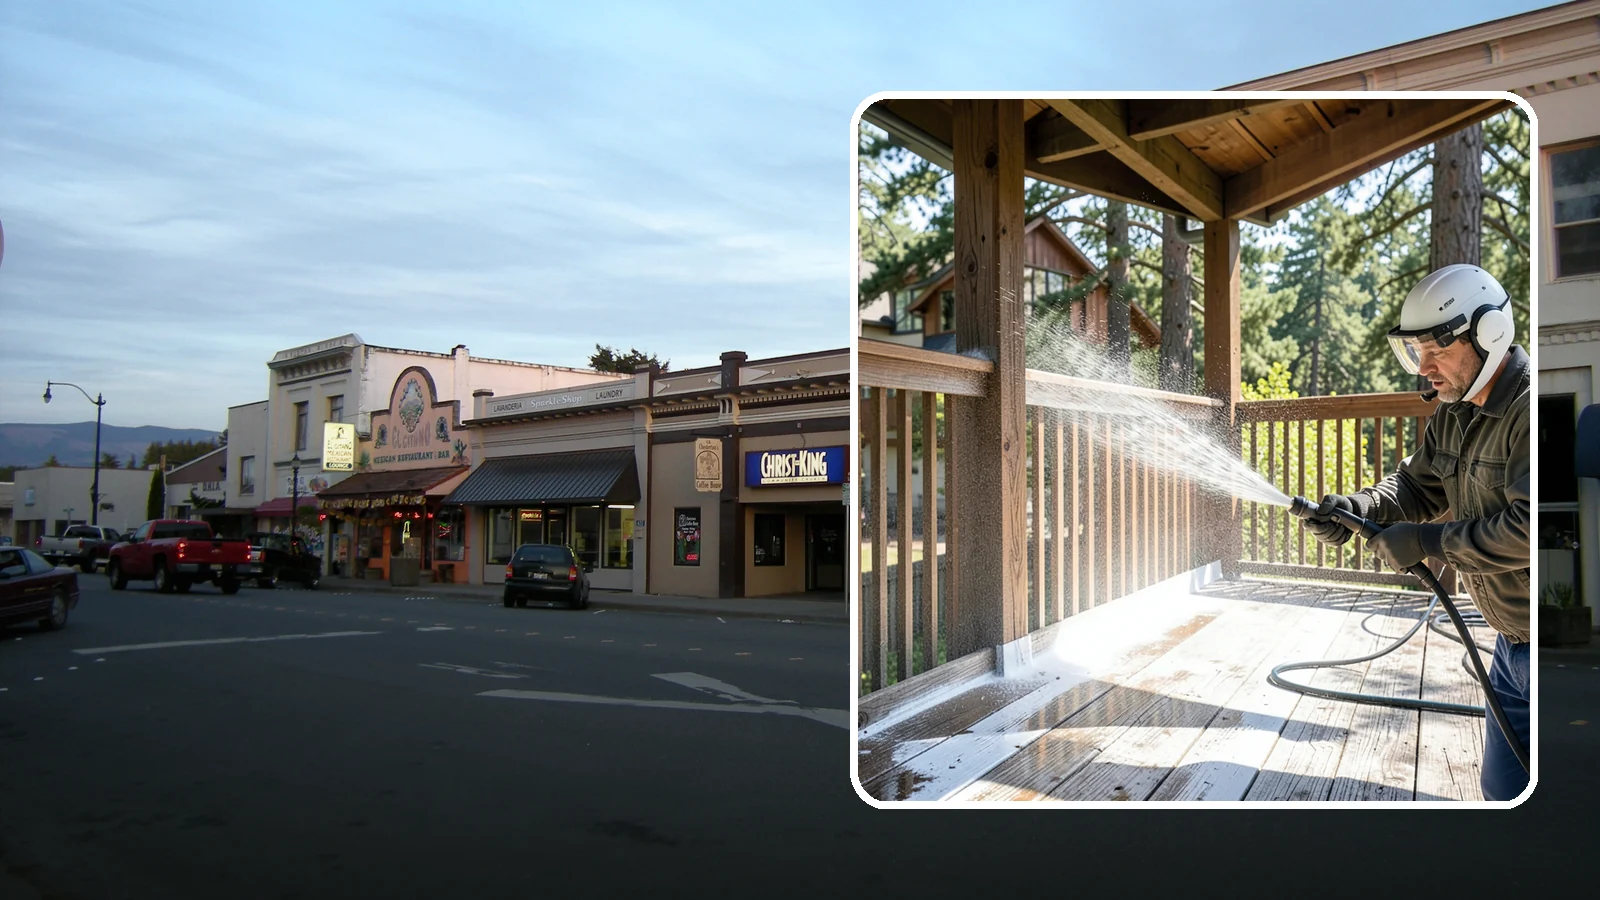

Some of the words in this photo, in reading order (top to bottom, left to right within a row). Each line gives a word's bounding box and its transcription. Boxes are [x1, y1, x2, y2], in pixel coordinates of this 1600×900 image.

[595, 389, 623, 400] LAUNDRY
[493, 402, 522, 412] LAVANDERIA
[531, 396, 561, 408] Sparkle
[562, 395, 582, 404] Shop
[373, 455, 396, 464] MEXICAN
[397, 451, 433, 462] RESTAURANT
[437, 450, 450, 458] BAR
[761, 452, 797, 478] CHRIST
[799, 450, 827, 476] KING
